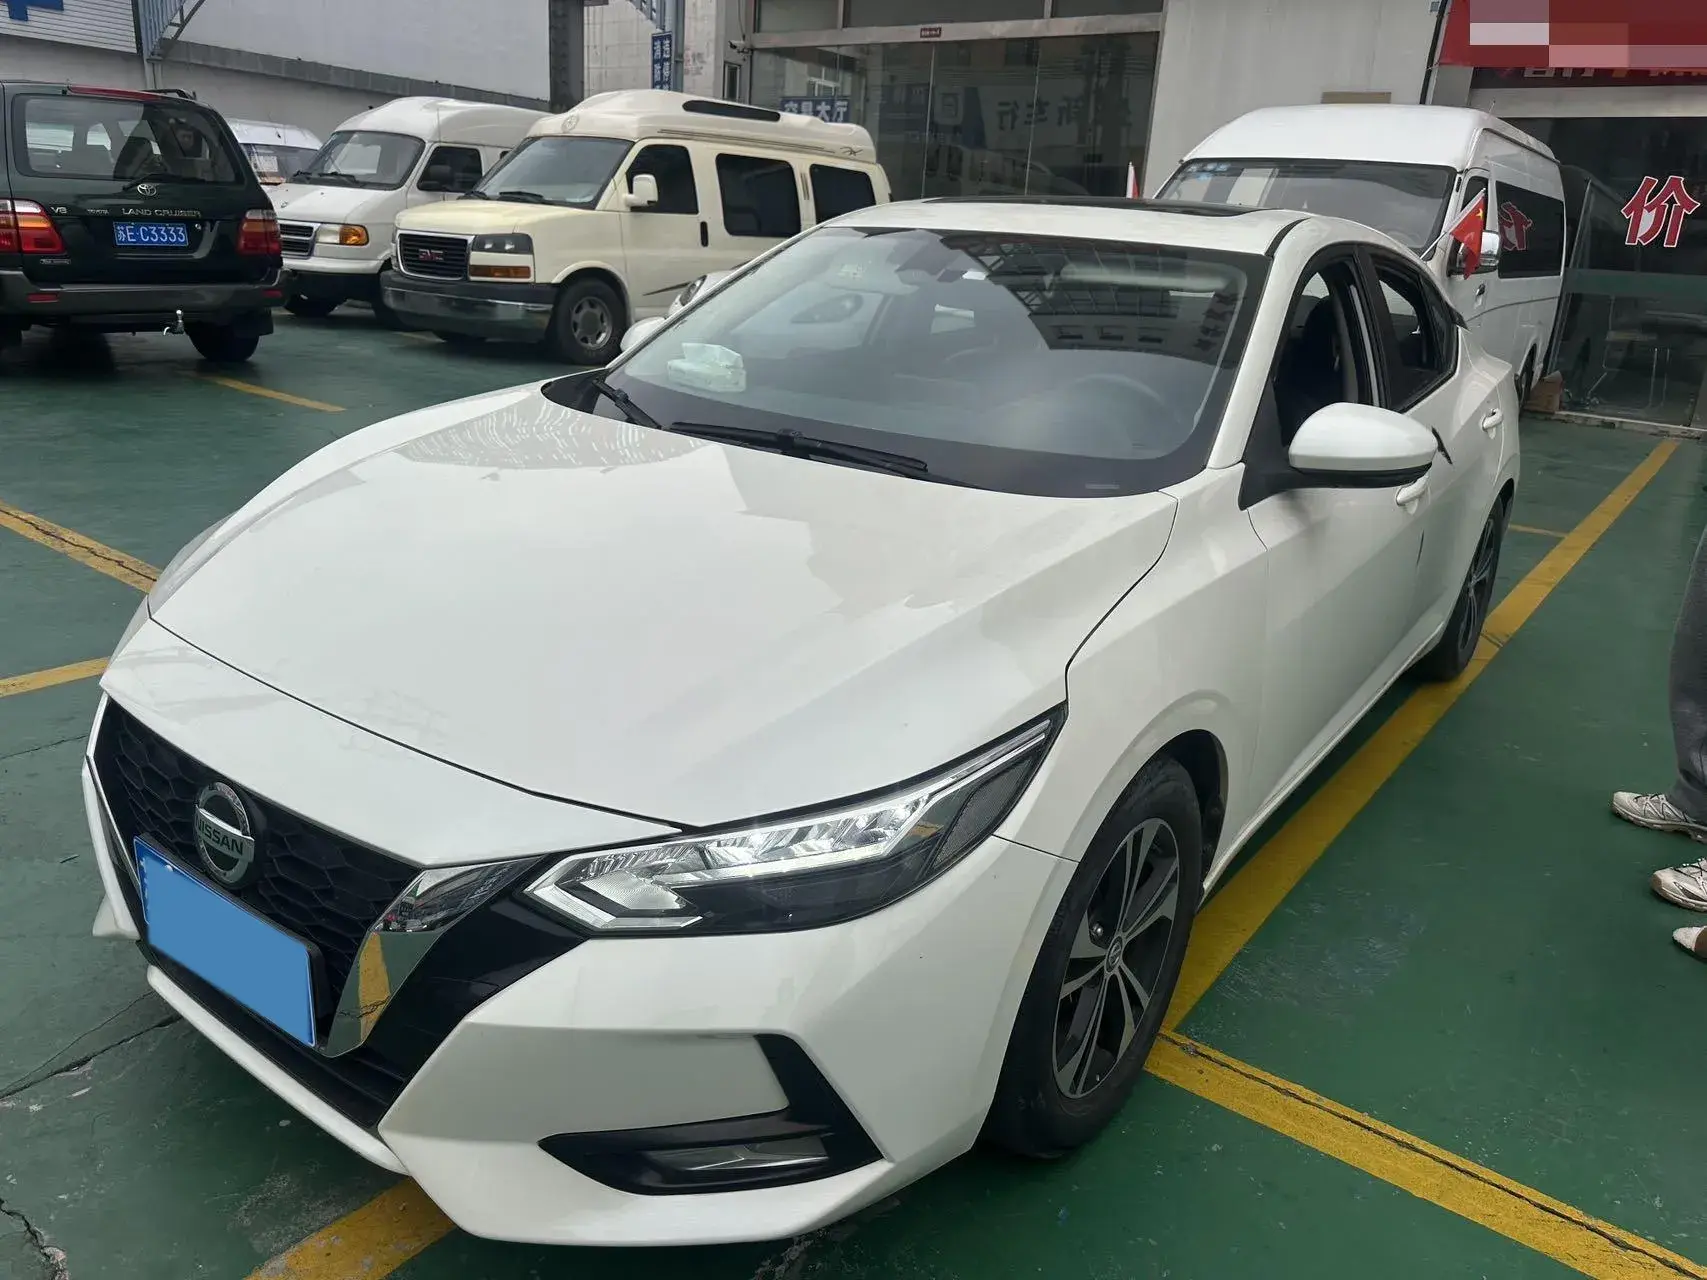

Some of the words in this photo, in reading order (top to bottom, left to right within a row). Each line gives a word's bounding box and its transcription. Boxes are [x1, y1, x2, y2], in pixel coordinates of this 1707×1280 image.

[121, 208, 153, 216] LAND
[154, 209, 202, 218] CRUISER
[1620, 175, 1701, 248] 价
[196, 817, 244, 856] NISSAN
